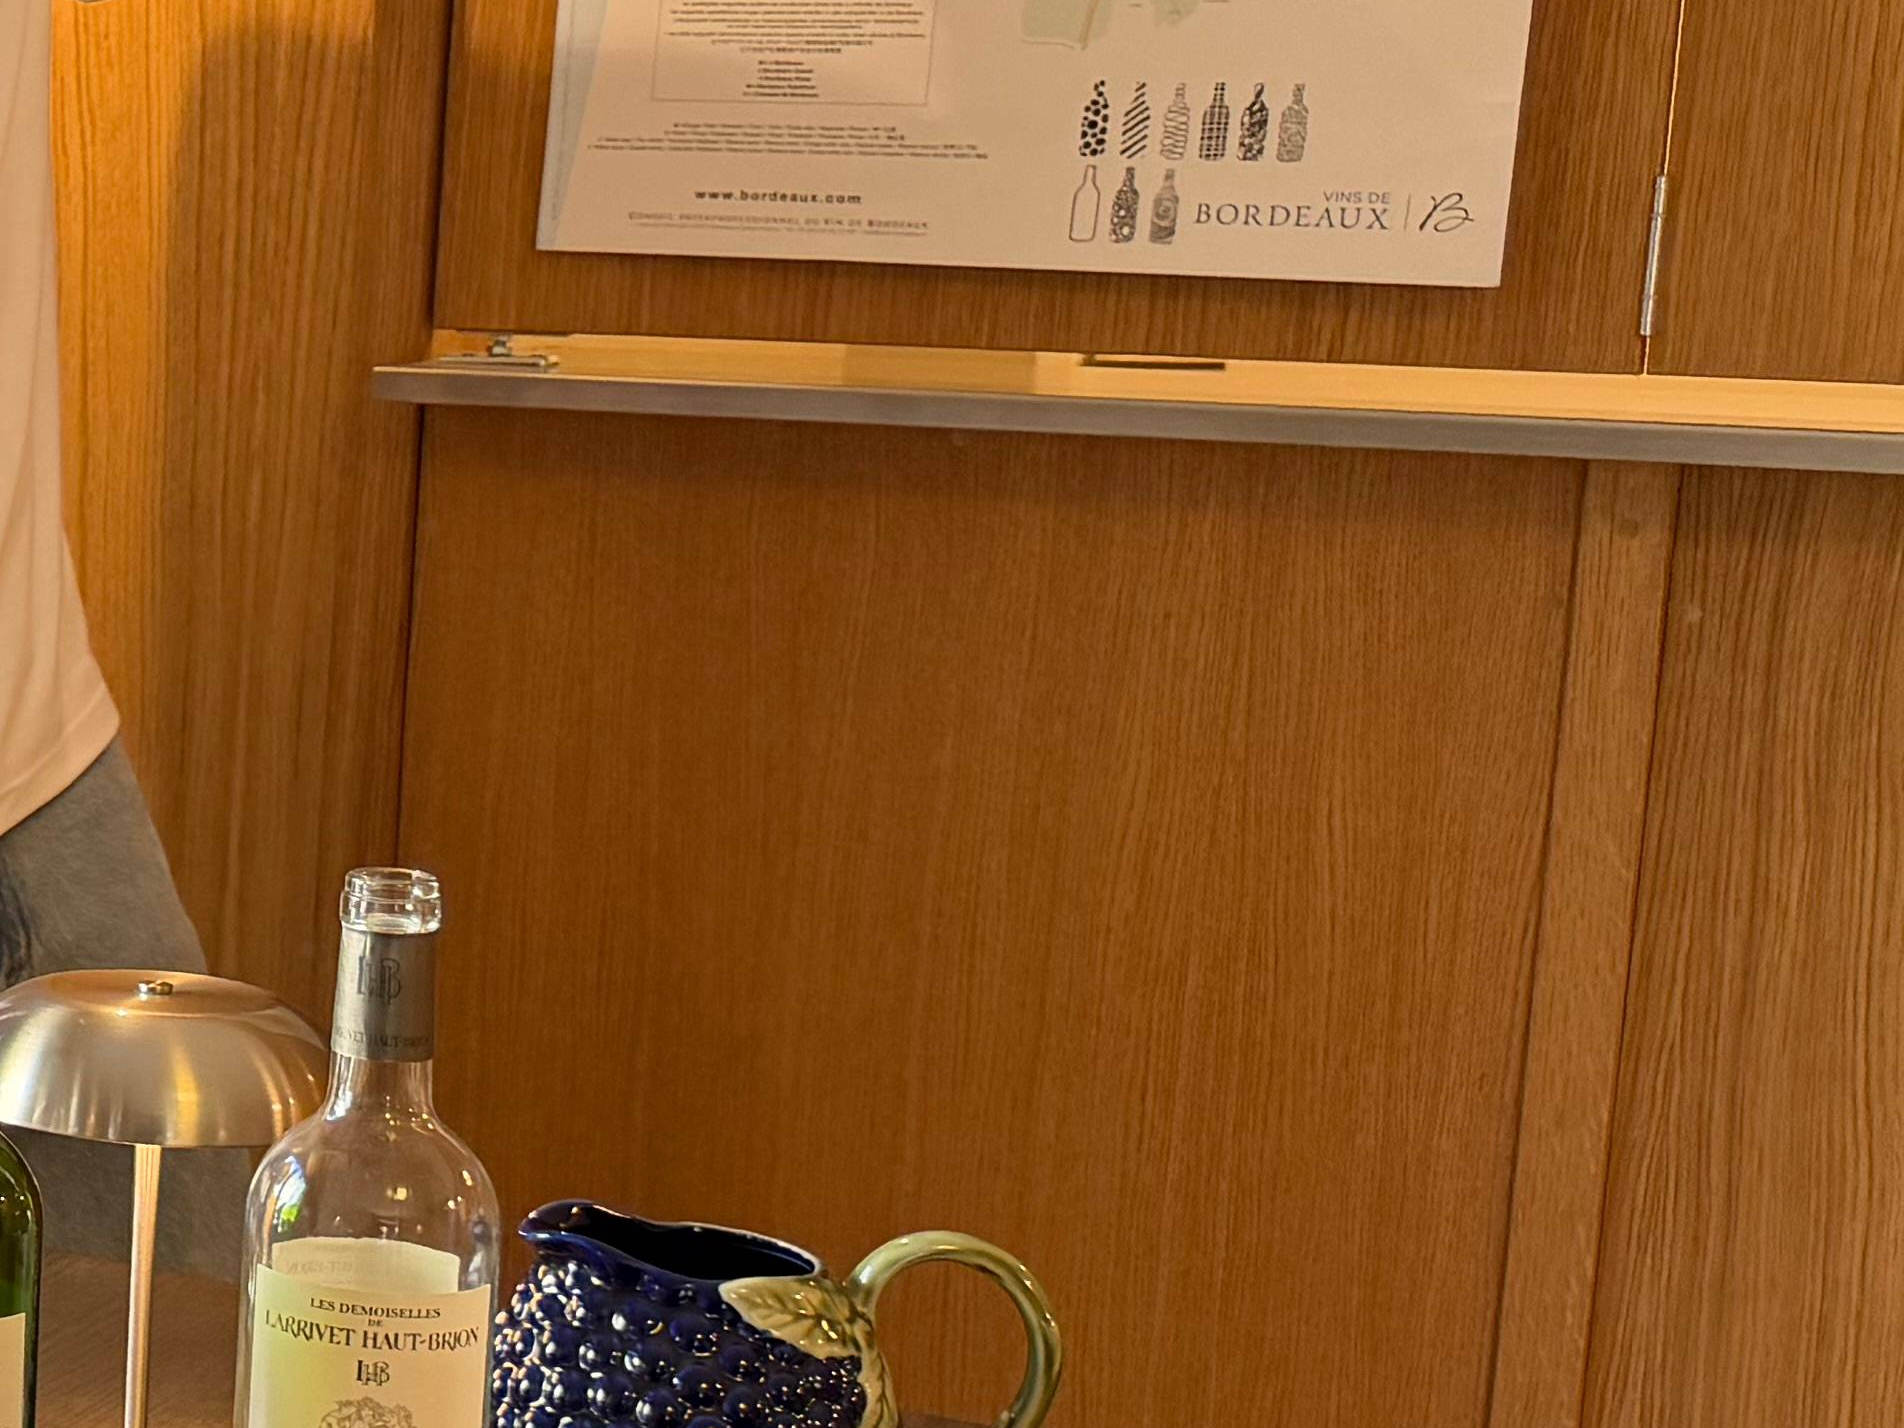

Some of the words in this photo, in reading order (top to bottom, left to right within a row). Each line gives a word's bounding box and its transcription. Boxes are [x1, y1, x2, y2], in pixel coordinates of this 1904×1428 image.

[694, 190, 862, 204] www.bordeaux.com
[1324, 191, 1362, 203] VINS
[1368, 192, 1390, 204] DE
[1195, 203, 1390, 230] BORDEAUX
[311, 1297, 335, 1313] LES
[339, 1302, 441, 1318] DEMOISELLES
[265, 1309, 356, 1346] LARRIVET
[362, 1325, 479, 1352] HAUT-BRION
[368, 1319, 383, 1327] DE
